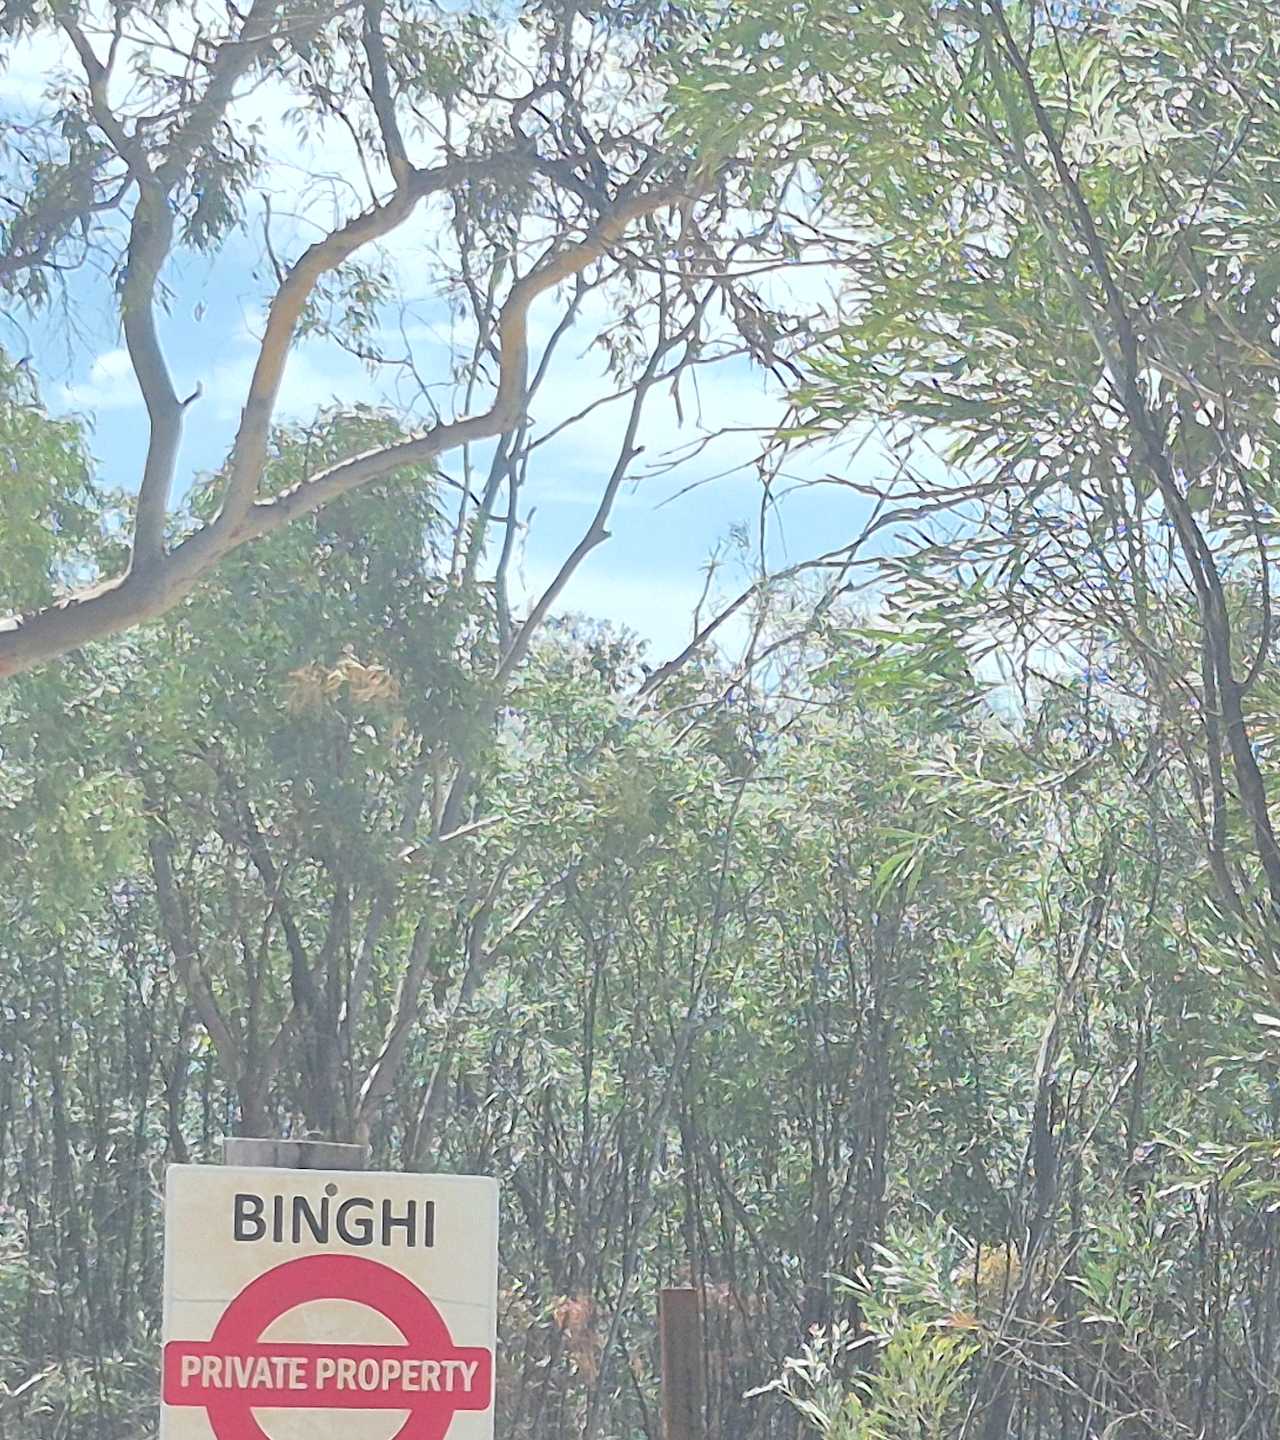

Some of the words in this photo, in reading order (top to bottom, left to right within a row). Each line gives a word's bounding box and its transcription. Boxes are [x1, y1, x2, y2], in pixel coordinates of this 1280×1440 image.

[233, 1193, 435, 1247] BINGHI
[180, 1354, 308, 1389] PRIVATE
[316, 1357, 480, 1392] PROPERTY
